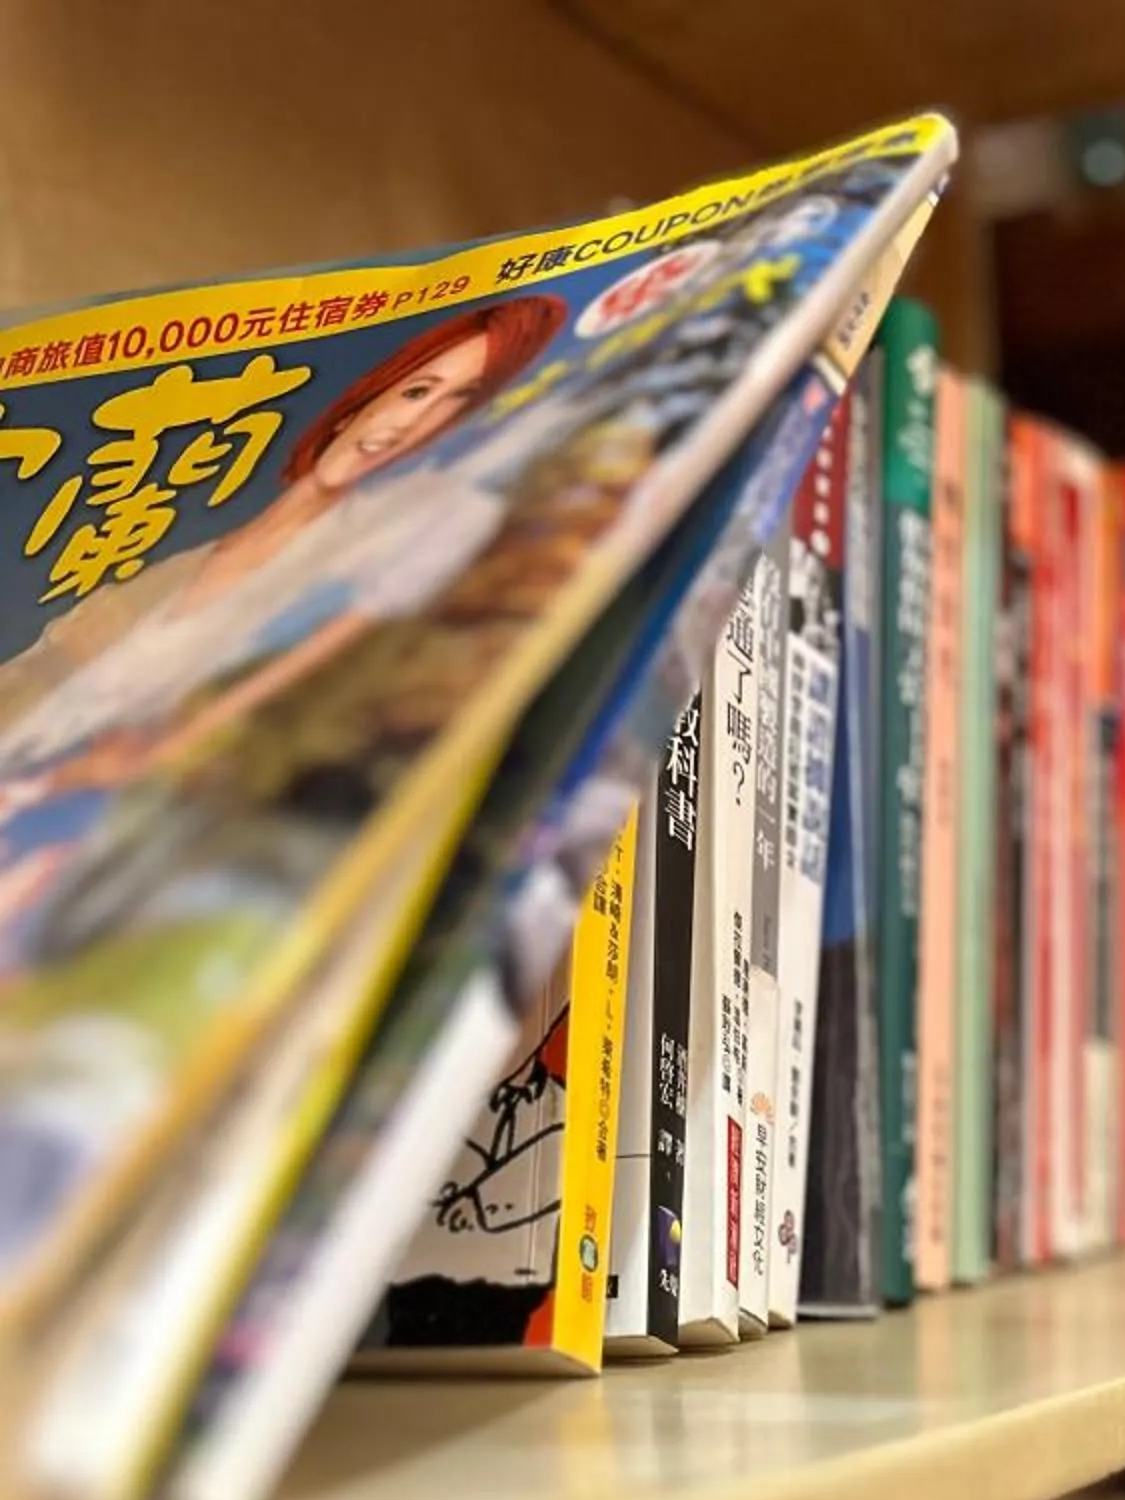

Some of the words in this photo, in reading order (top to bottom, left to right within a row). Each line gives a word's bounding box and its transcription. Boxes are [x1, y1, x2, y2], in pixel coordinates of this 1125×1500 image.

[0, 289, 390, 378] 商旅值10,000元住宿券
[394, 275, 471, 311] P129
